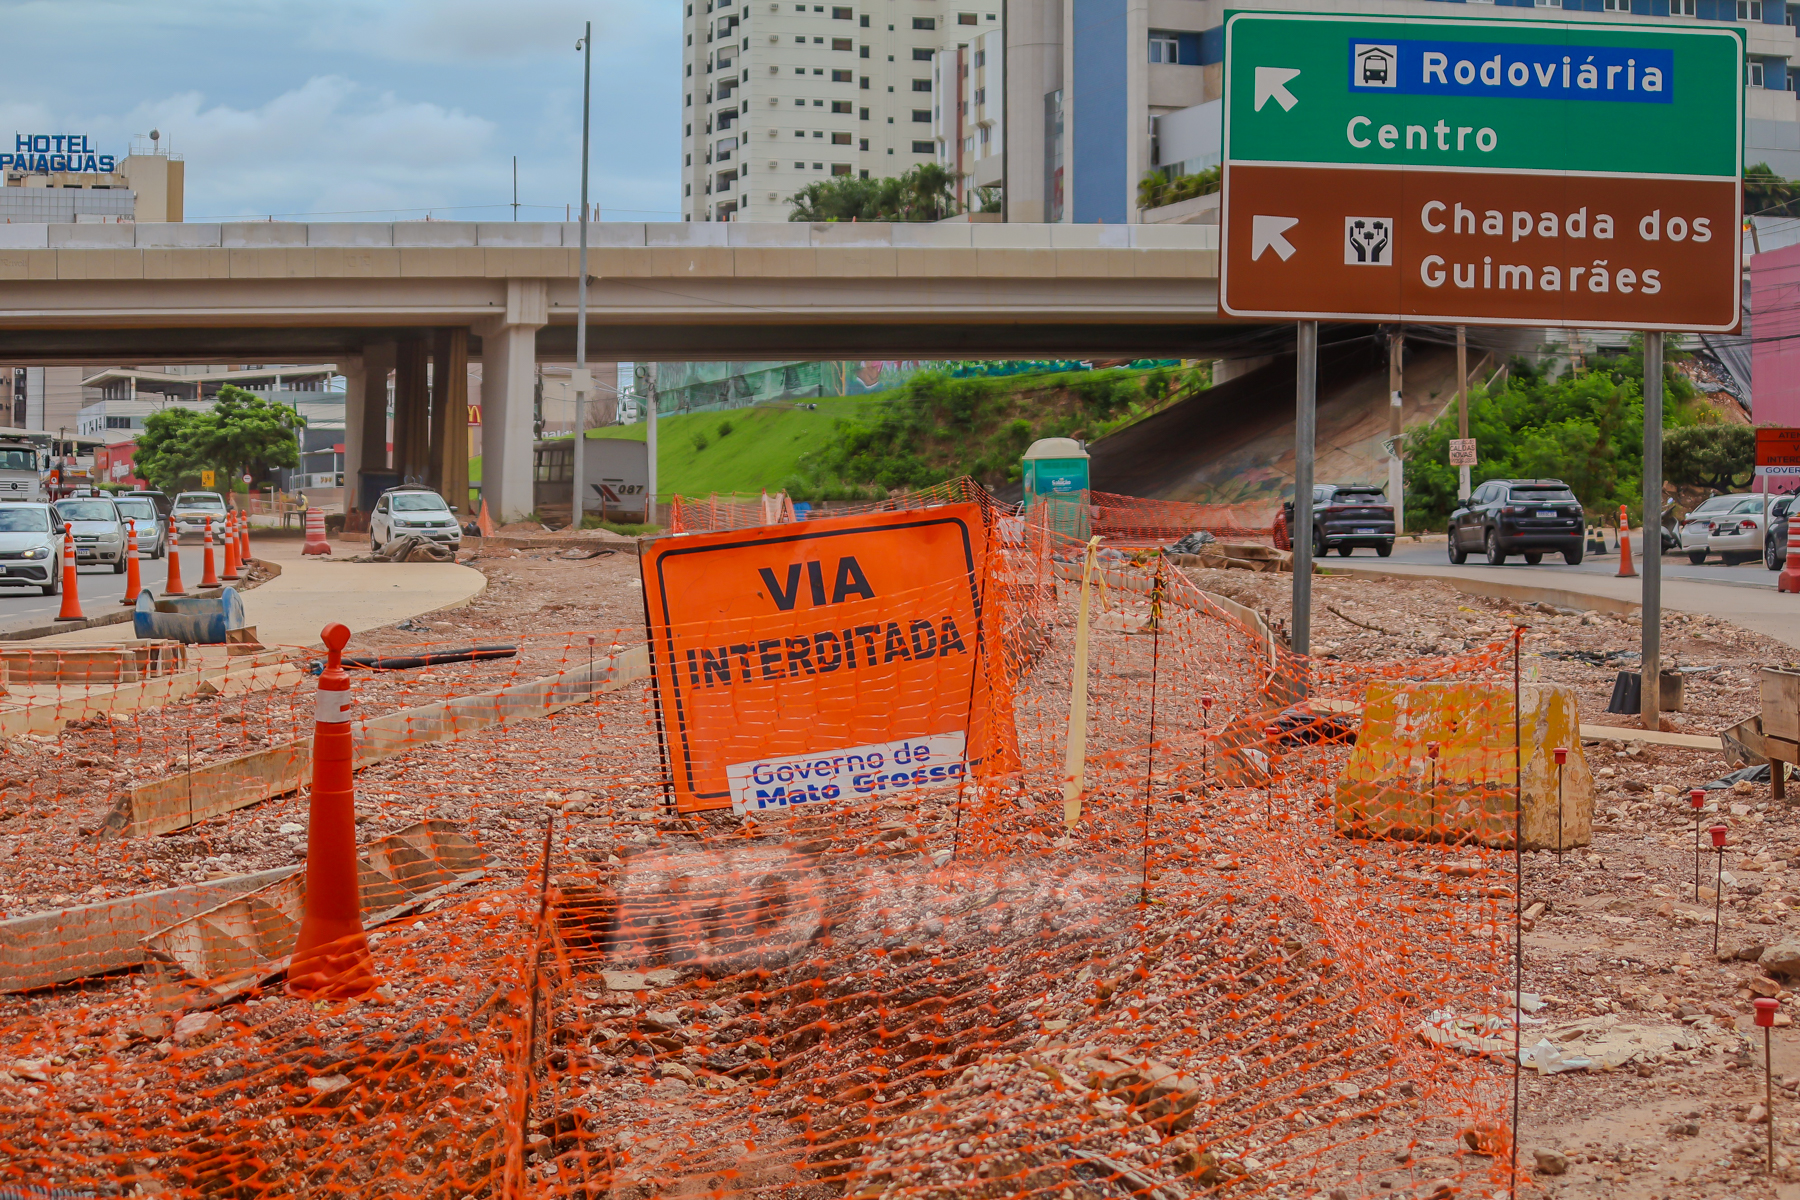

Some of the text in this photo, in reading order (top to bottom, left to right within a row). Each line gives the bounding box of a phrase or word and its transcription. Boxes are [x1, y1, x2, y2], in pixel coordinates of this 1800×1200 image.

[1422, 51, 1664, 92] Rodoviária
[16, 134, 94, 153] HOTEL
[1346, 115, 1498, 152] Centro
[0, 153, 114, 172] PAIAGUAS
[1420, 200, 1712, 242] Chapada dos
[1420, 254, 1662, 295] Guimarães
[617, 484, 645, 495] 087
[757, 555, 876, 612] VIA
[686, 615, 967, 690] INTERDITADA
[752, 742, 932, 787] Governo de
[755, 760, 966, 809] Mato Grosso
